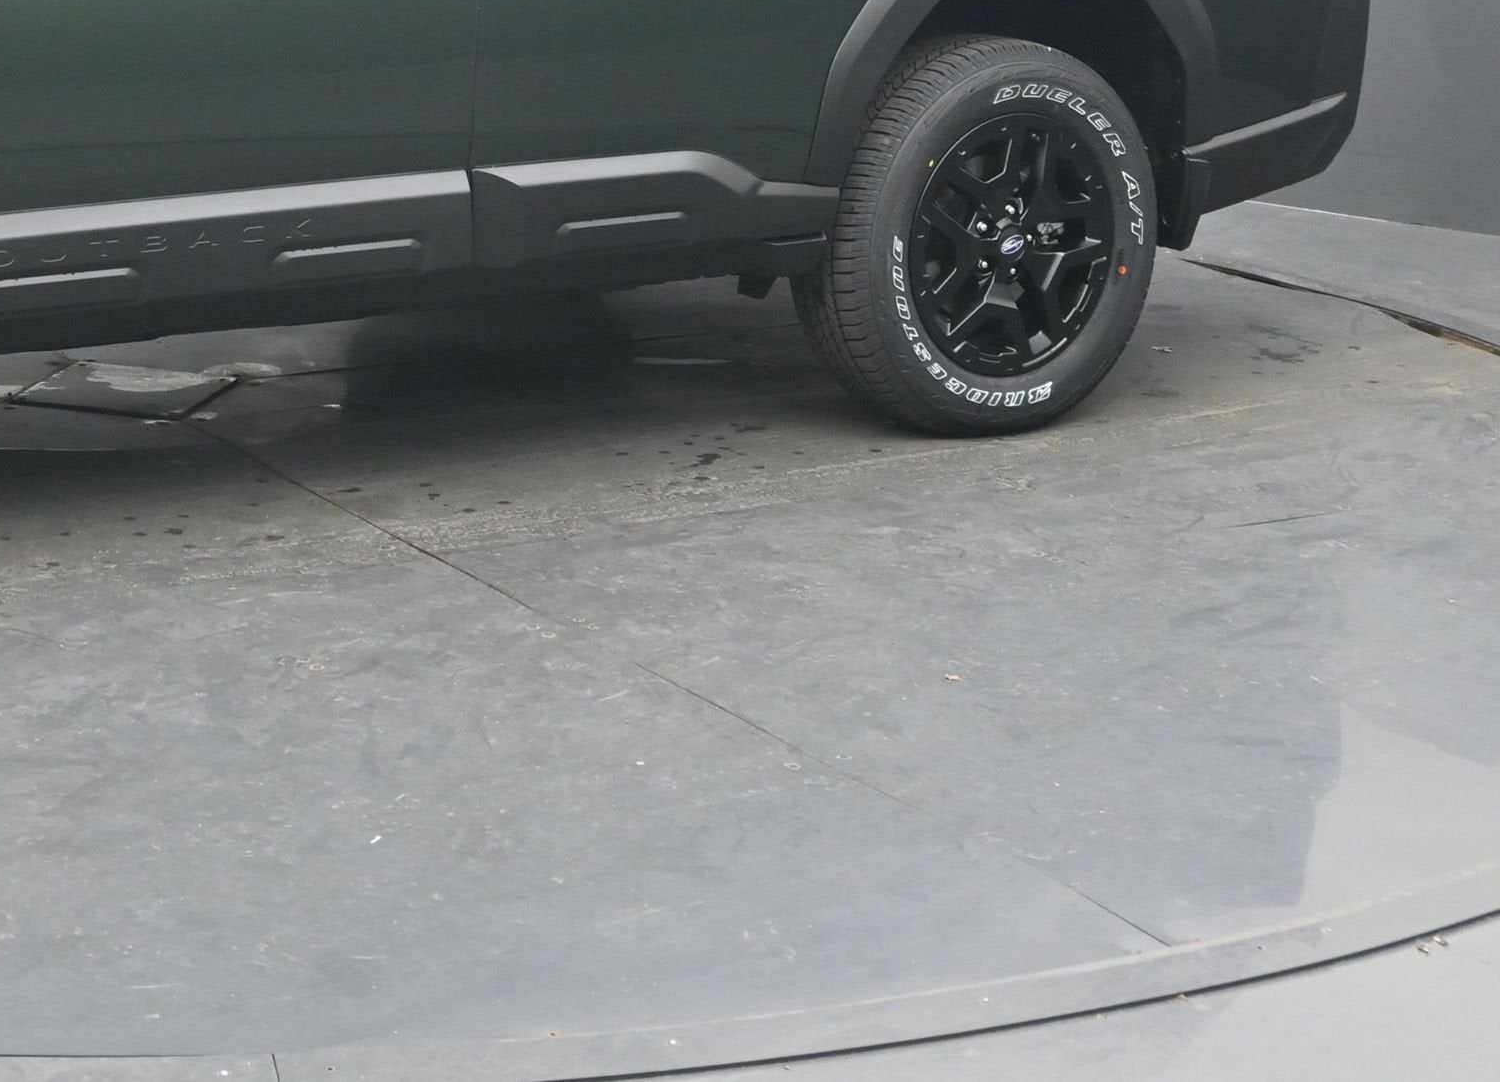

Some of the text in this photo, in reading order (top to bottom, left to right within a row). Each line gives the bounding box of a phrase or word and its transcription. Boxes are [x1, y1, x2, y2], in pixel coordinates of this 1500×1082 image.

[993, 84, 1144, 246] DUELER A/T
[892, 235, 1054, 407] BRIDGESTONE
